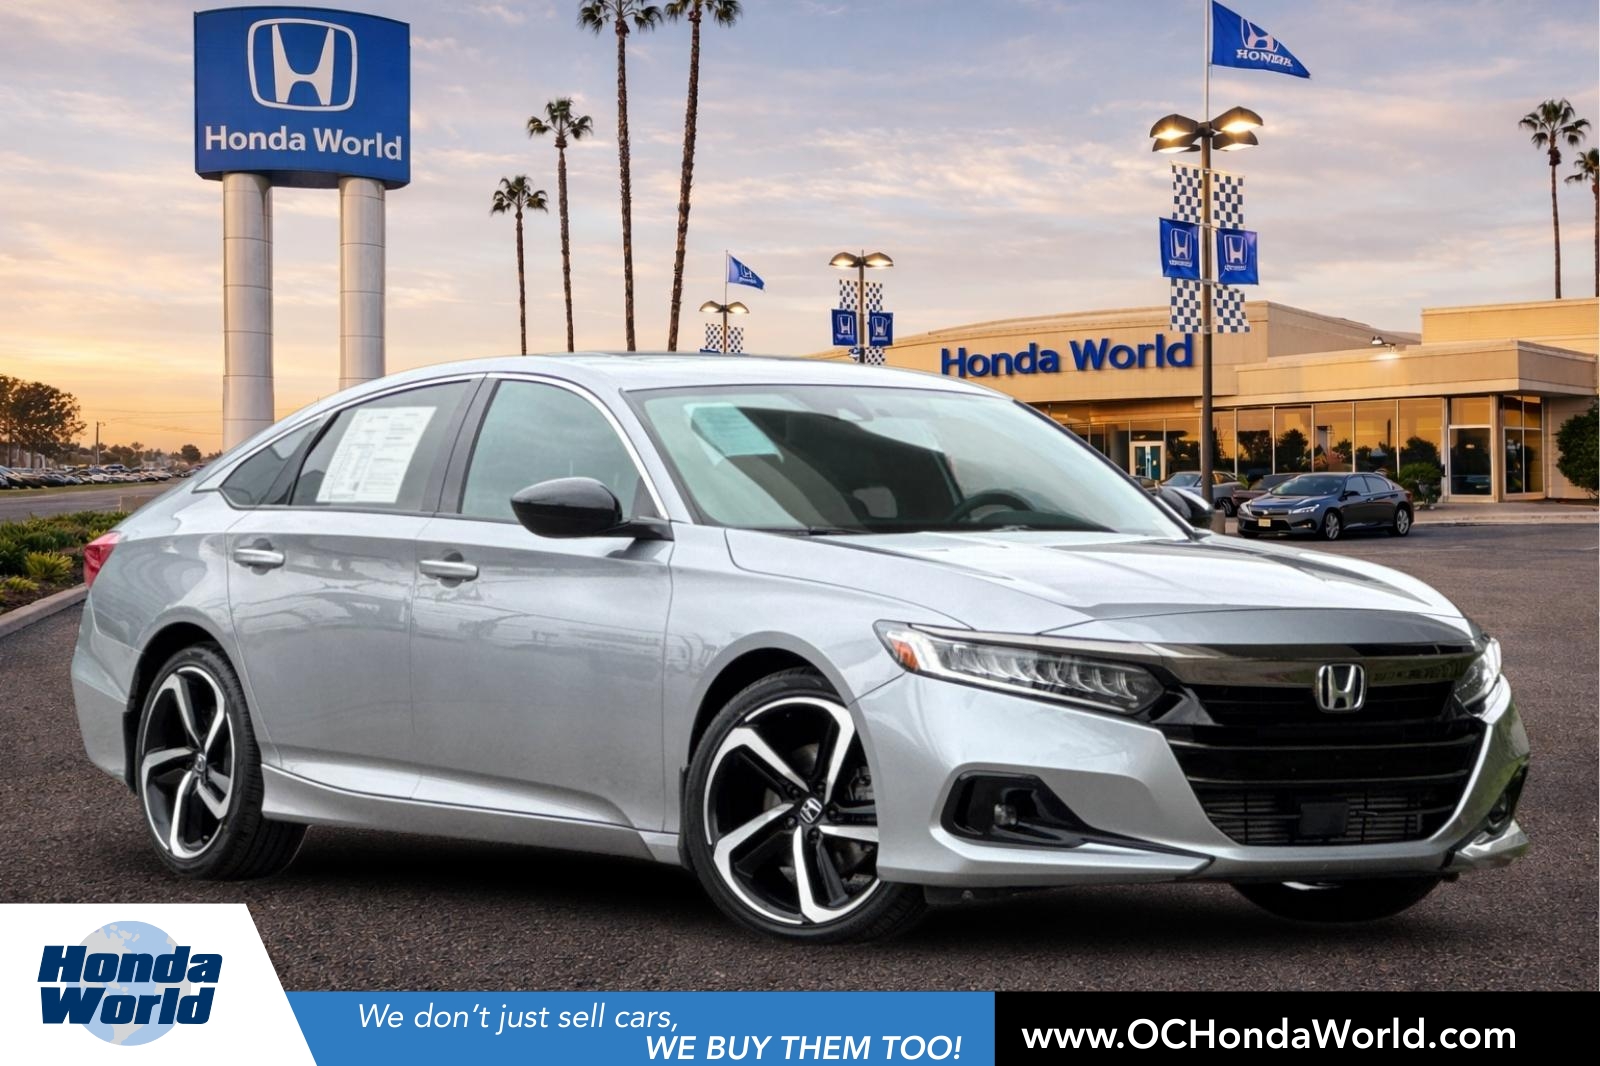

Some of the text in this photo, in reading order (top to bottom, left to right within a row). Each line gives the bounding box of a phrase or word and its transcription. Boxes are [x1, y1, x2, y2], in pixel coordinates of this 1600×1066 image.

[205, 125, 402, 160] Honda World
[941, 333, 1194, 378] Honda World
